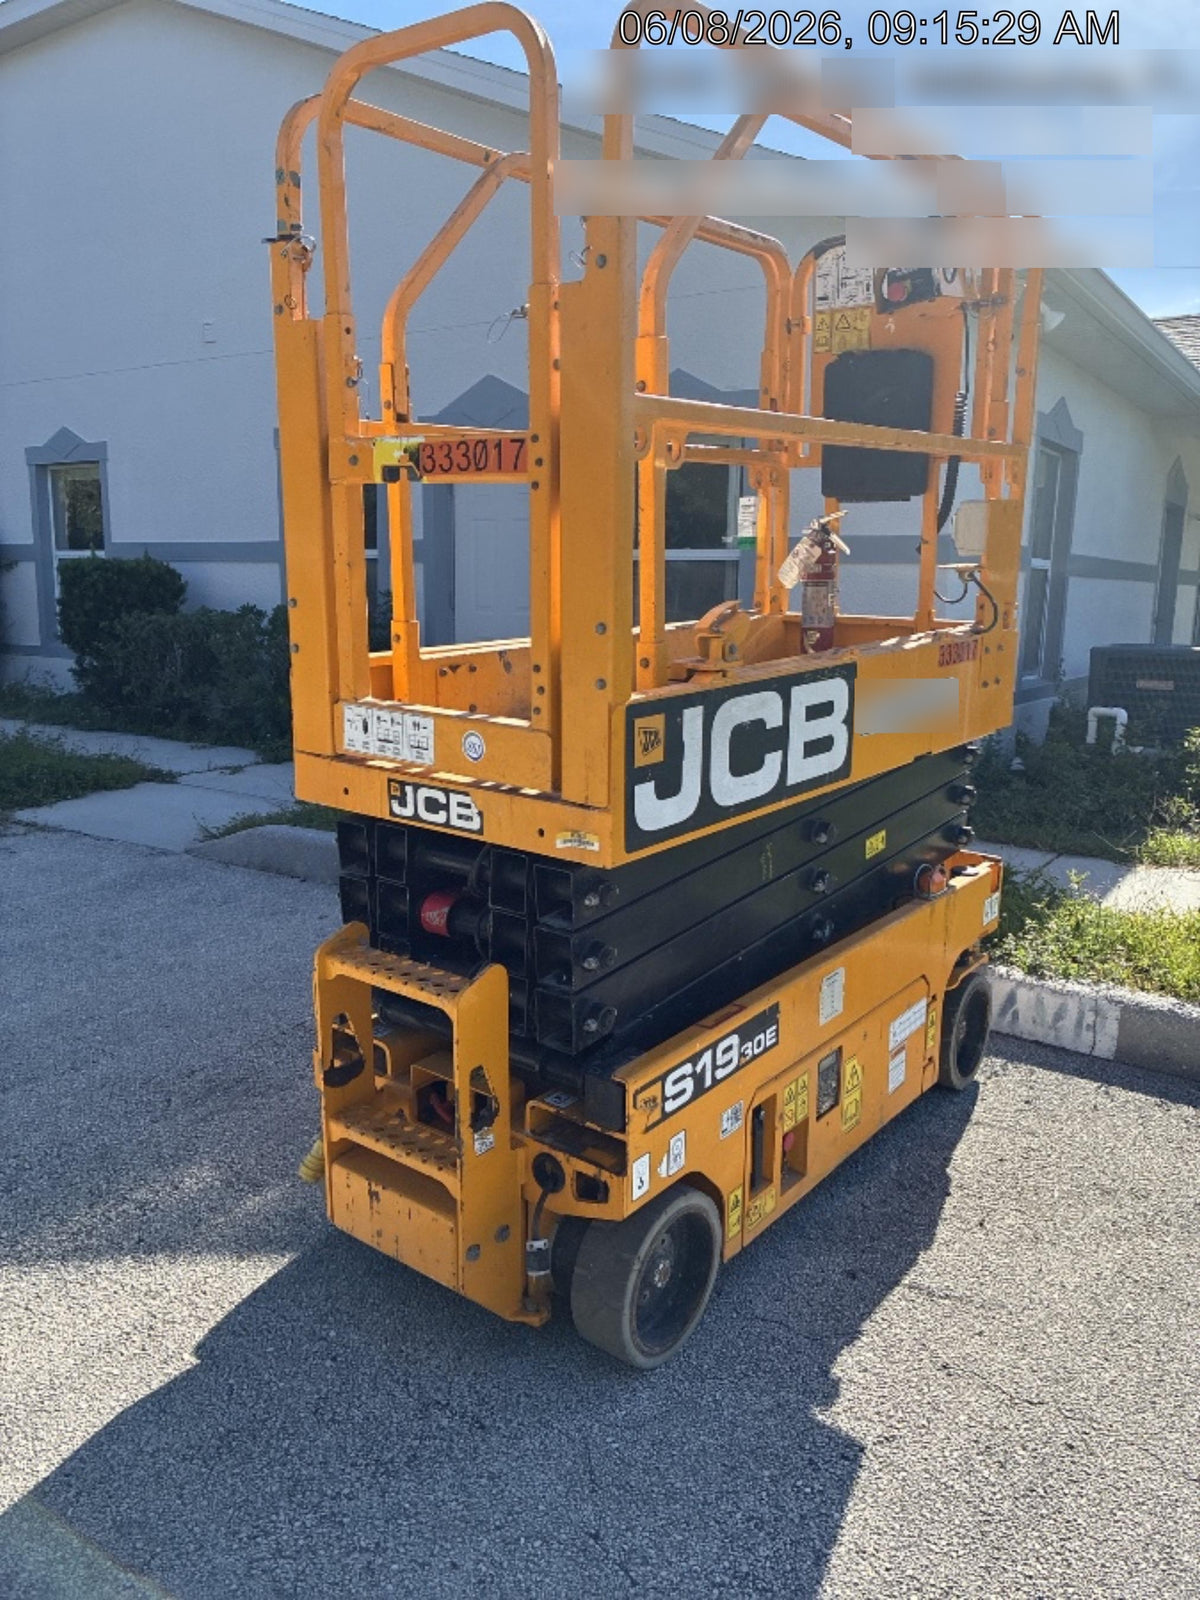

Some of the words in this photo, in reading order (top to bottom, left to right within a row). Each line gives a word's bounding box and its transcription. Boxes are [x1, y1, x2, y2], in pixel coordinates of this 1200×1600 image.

[422, 438, 526, 474] 333017
[634, 677, 849, 831] JCB
[390, 785, 481, 831] JCB
